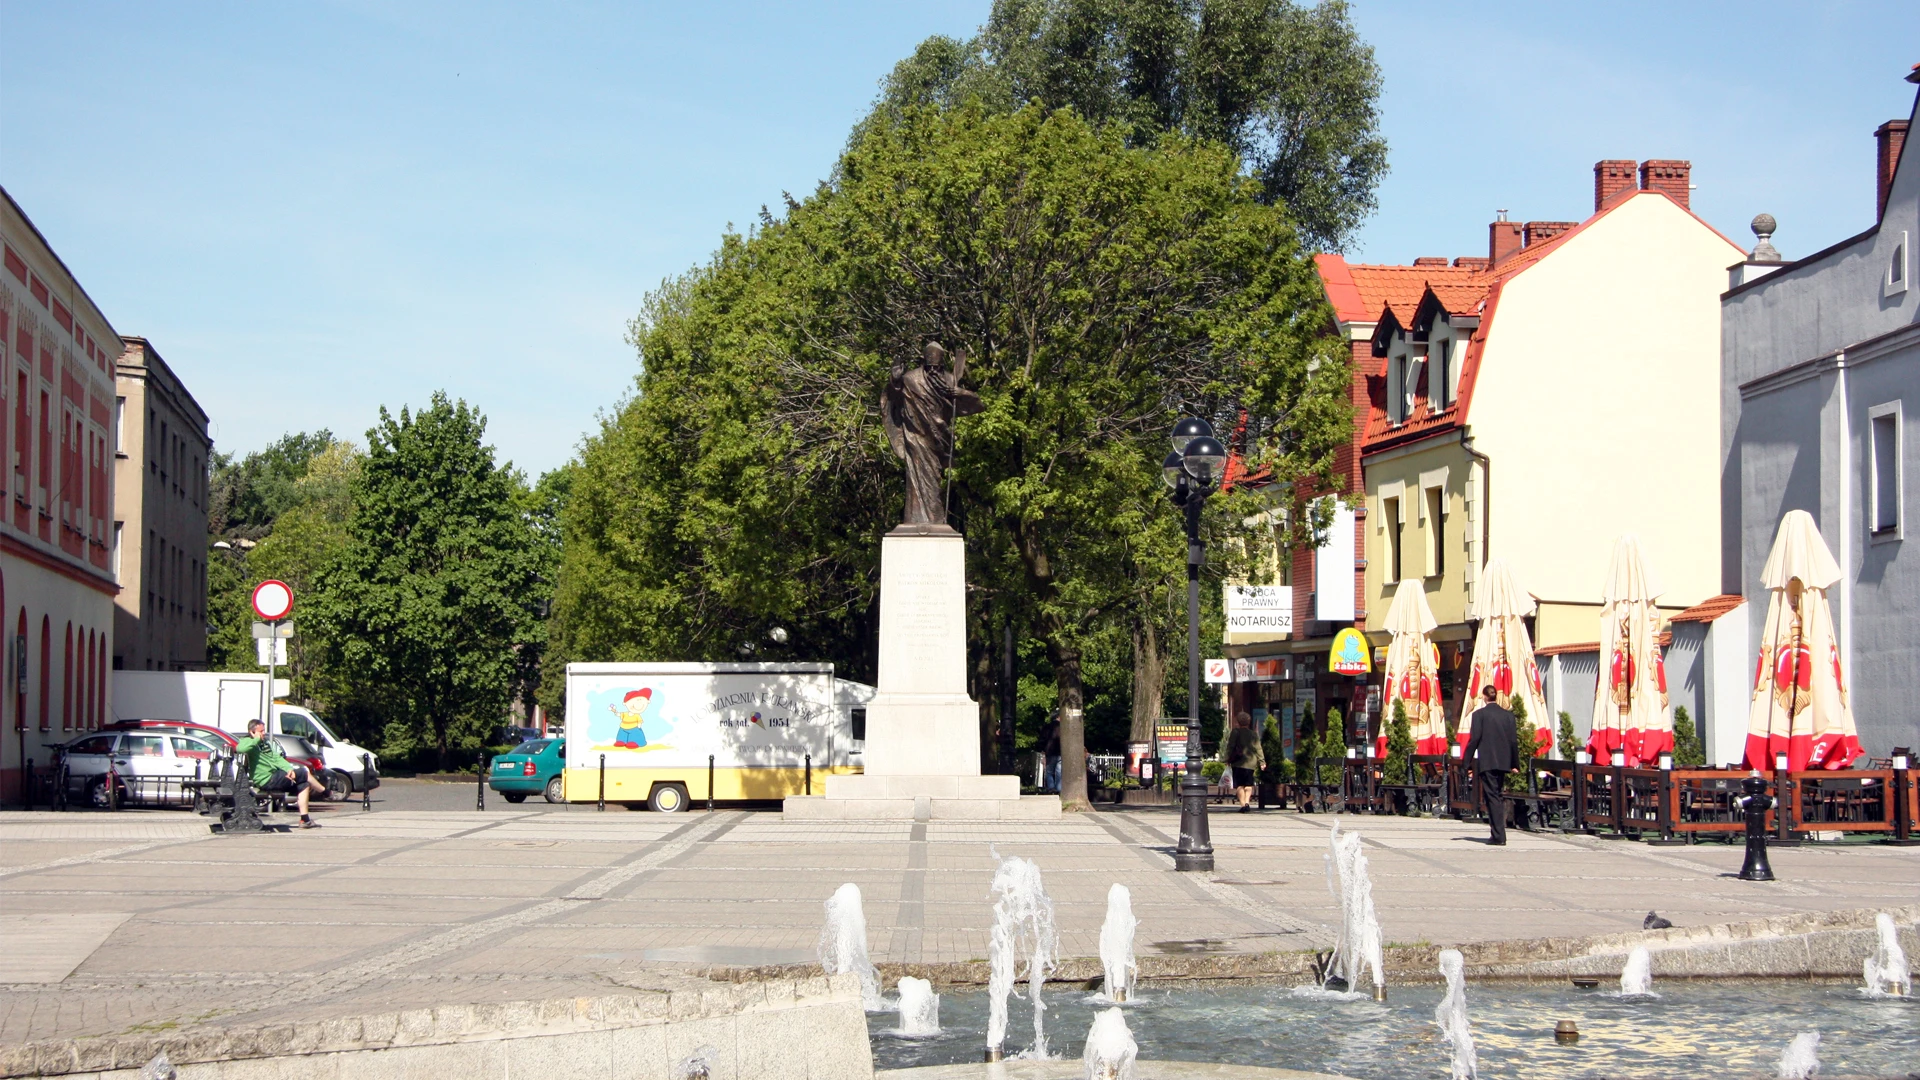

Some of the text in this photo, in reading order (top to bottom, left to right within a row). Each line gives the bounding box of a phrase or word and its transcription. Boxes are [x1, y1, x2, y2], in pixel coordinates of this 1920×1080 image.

[1242, 598, 1279, 607] PRAWNY
[1230, 615, 1291, 627] NOTARIUSZ
[1334, 661, 1368, 671] żabka
[719, 717, 733, 728] rok
[768, 717, 790, 728] 1954
